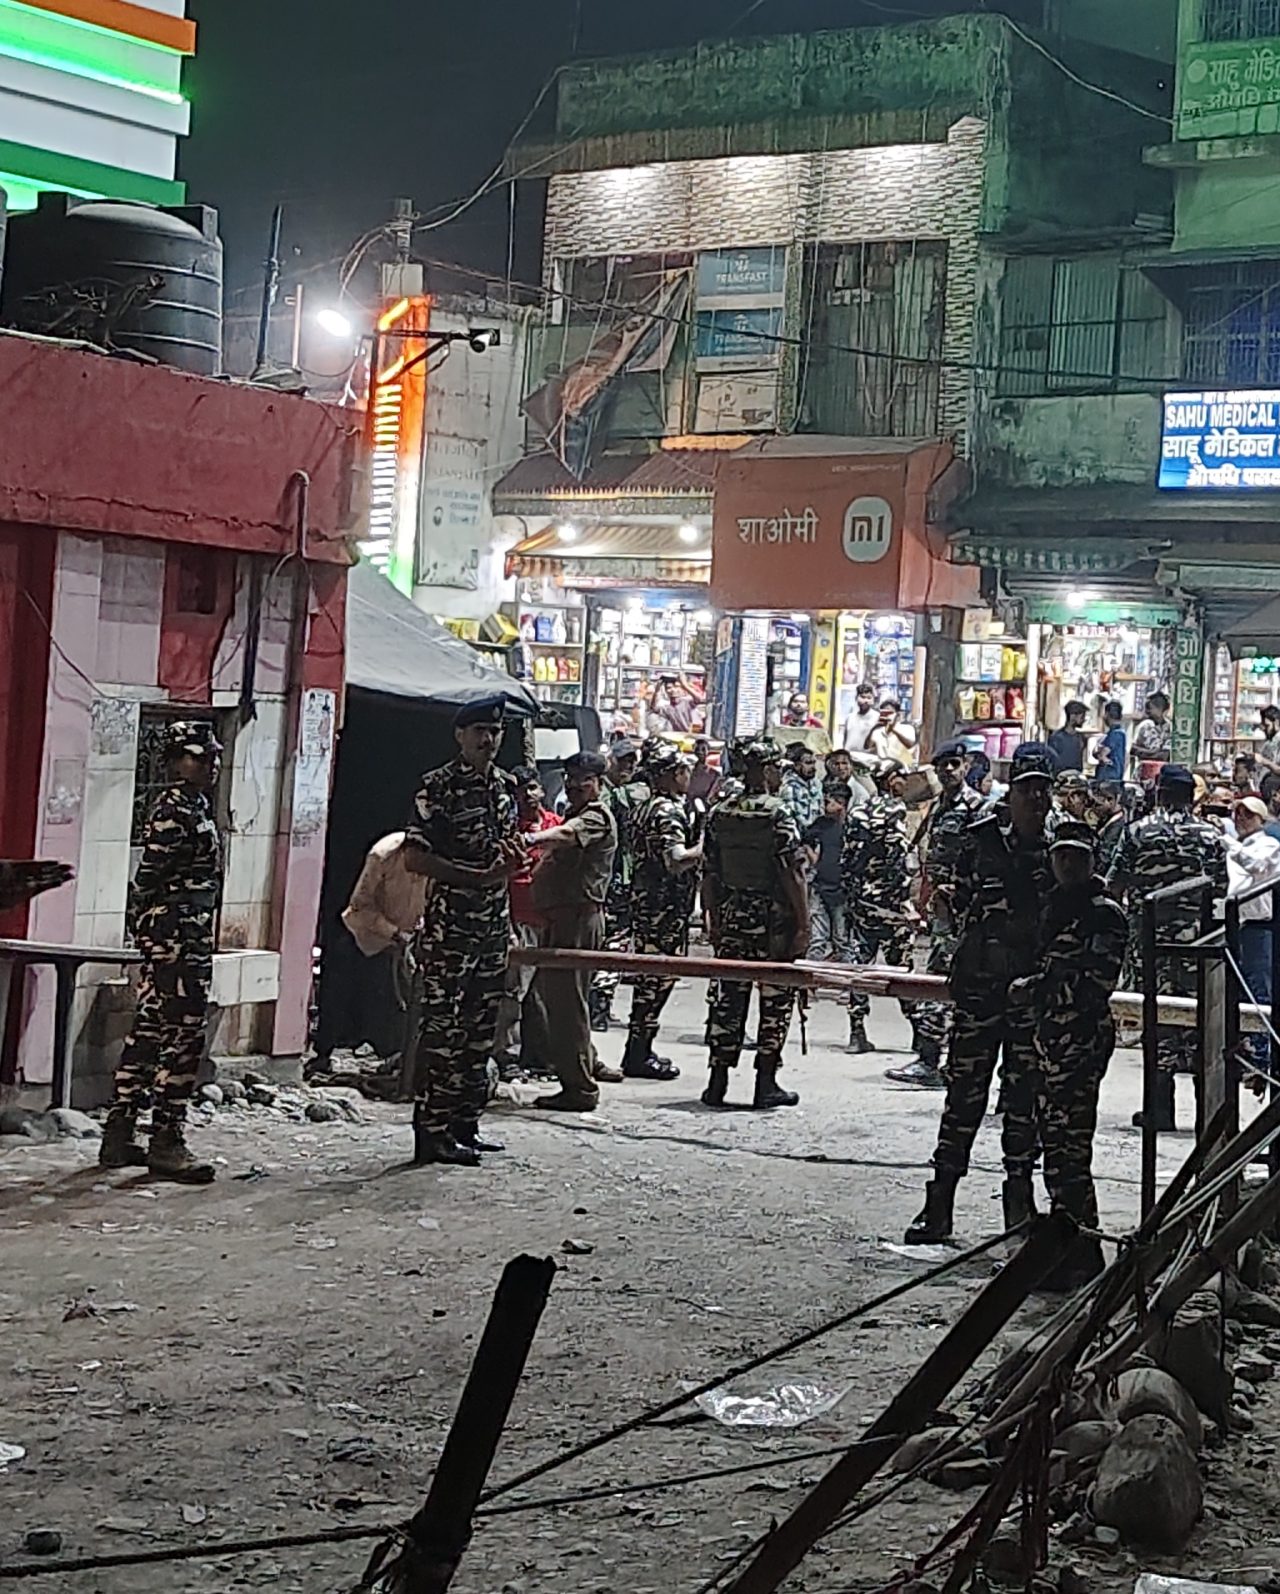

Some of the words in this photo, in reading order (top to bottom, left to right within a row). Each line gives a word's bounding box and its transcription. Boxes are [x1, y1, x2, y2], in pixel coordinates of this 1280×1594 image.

[1209, 57, 1242, 90] साहू
[1166, 404, 1208, 429] SAHU
[1209, 402, 1277, 428] MEDICAL
[1162, 434, 1204, 466] साहू
[1203, 426, 1277, 459] मेडिकल
[737, 506, 820, 544] शाओमी
